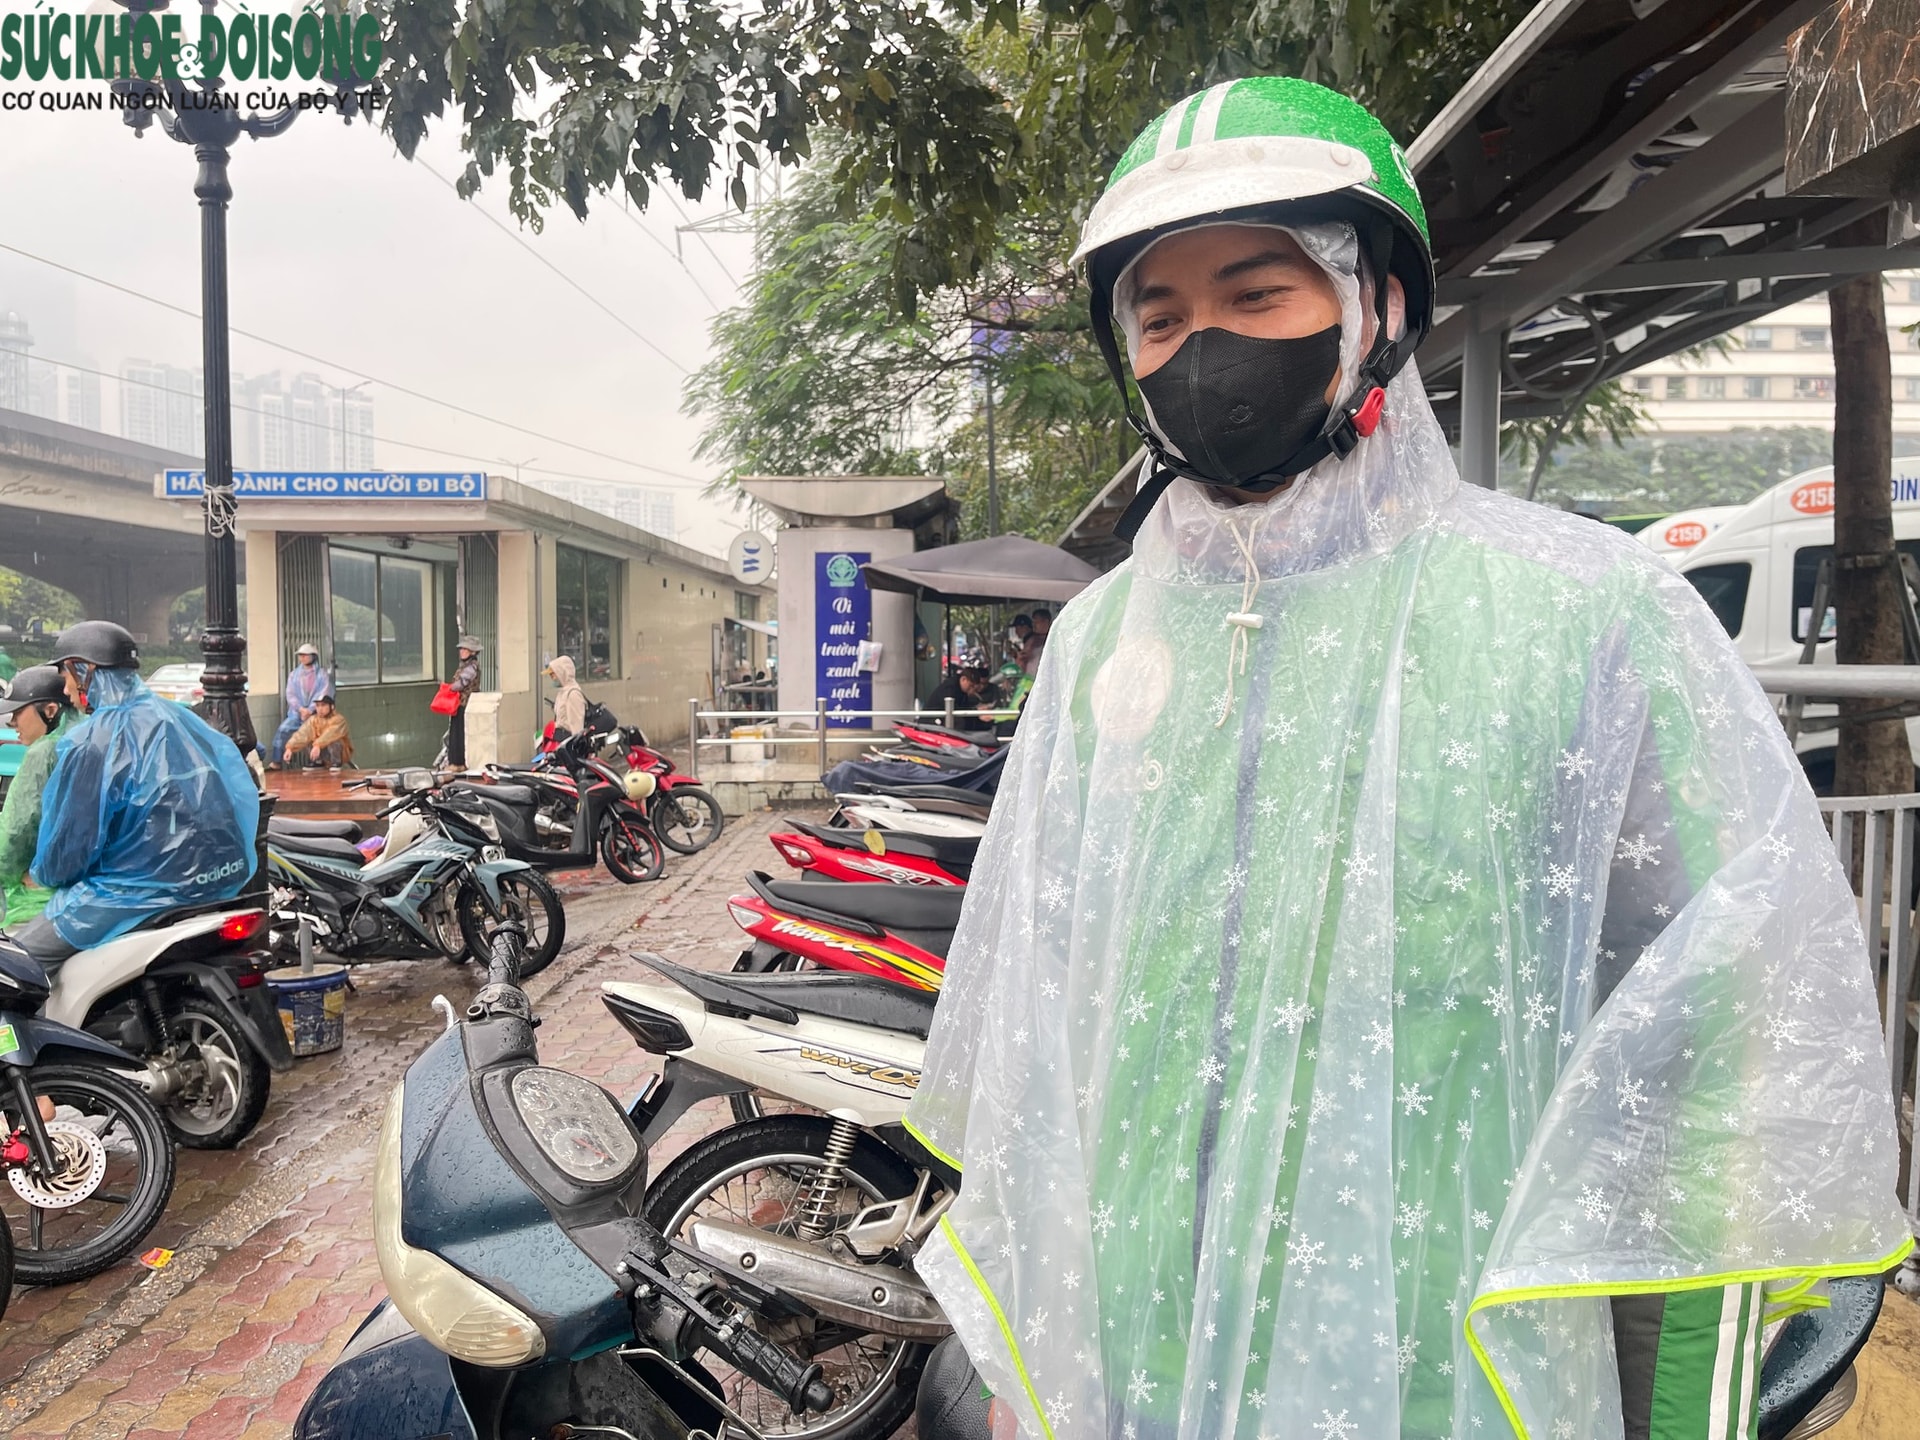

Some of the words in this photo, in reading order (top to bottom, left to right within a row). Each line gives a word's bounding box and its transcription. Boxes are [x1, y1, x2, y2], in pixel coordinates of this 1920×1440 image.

[171, 473, 206, 491] HẦ
[292, 476, 338, 492] CHO
[344, 474, 411, 492] NGƯỜI
[415, 477, 439, 492] ĐI
[445, 474, 476, 497] BỘ
[1668, 525, 1702, 543] 215B
[196, 858, 244, 885] adidas
